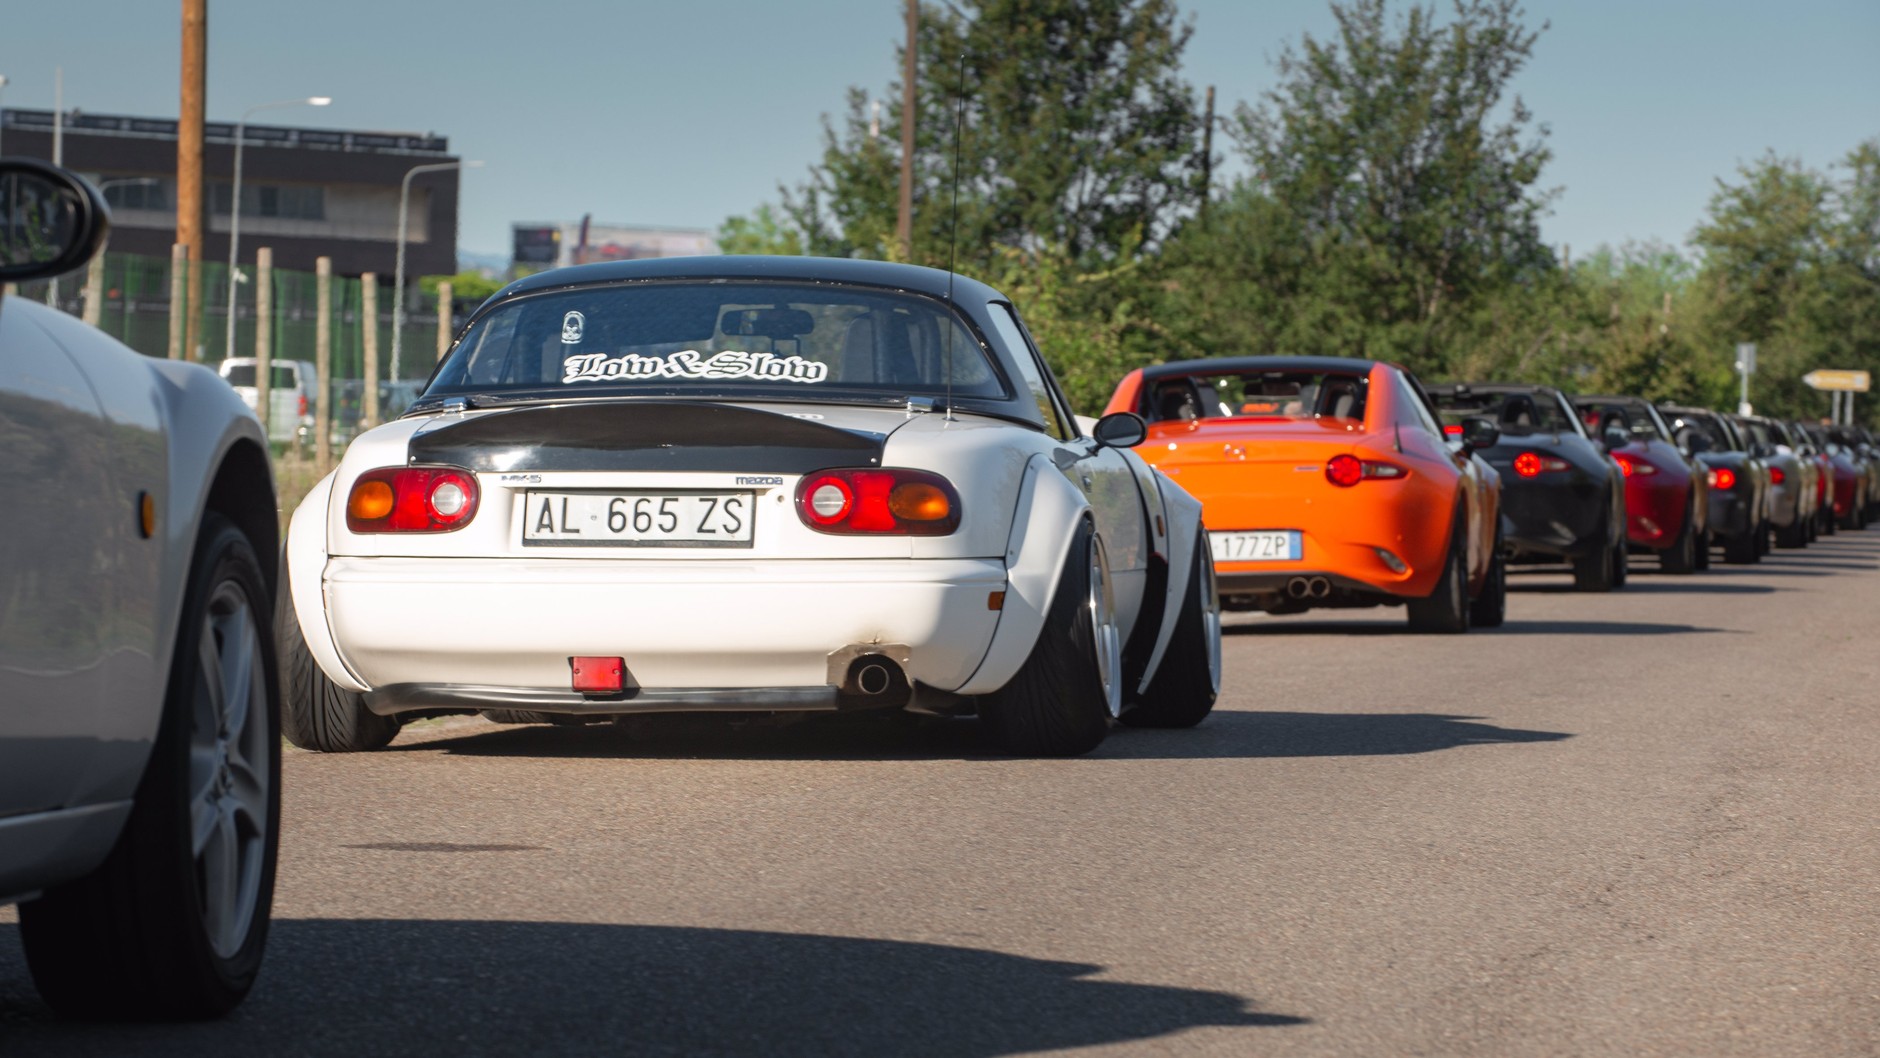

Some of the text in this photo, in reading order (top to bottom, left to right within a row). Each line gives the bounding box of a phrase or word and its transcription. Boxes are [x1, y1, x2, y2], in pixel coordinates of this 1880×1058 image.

[535, 497, 743, 534] AL 665 ZS
[1224, 535, 1286, 557] 177ZP
